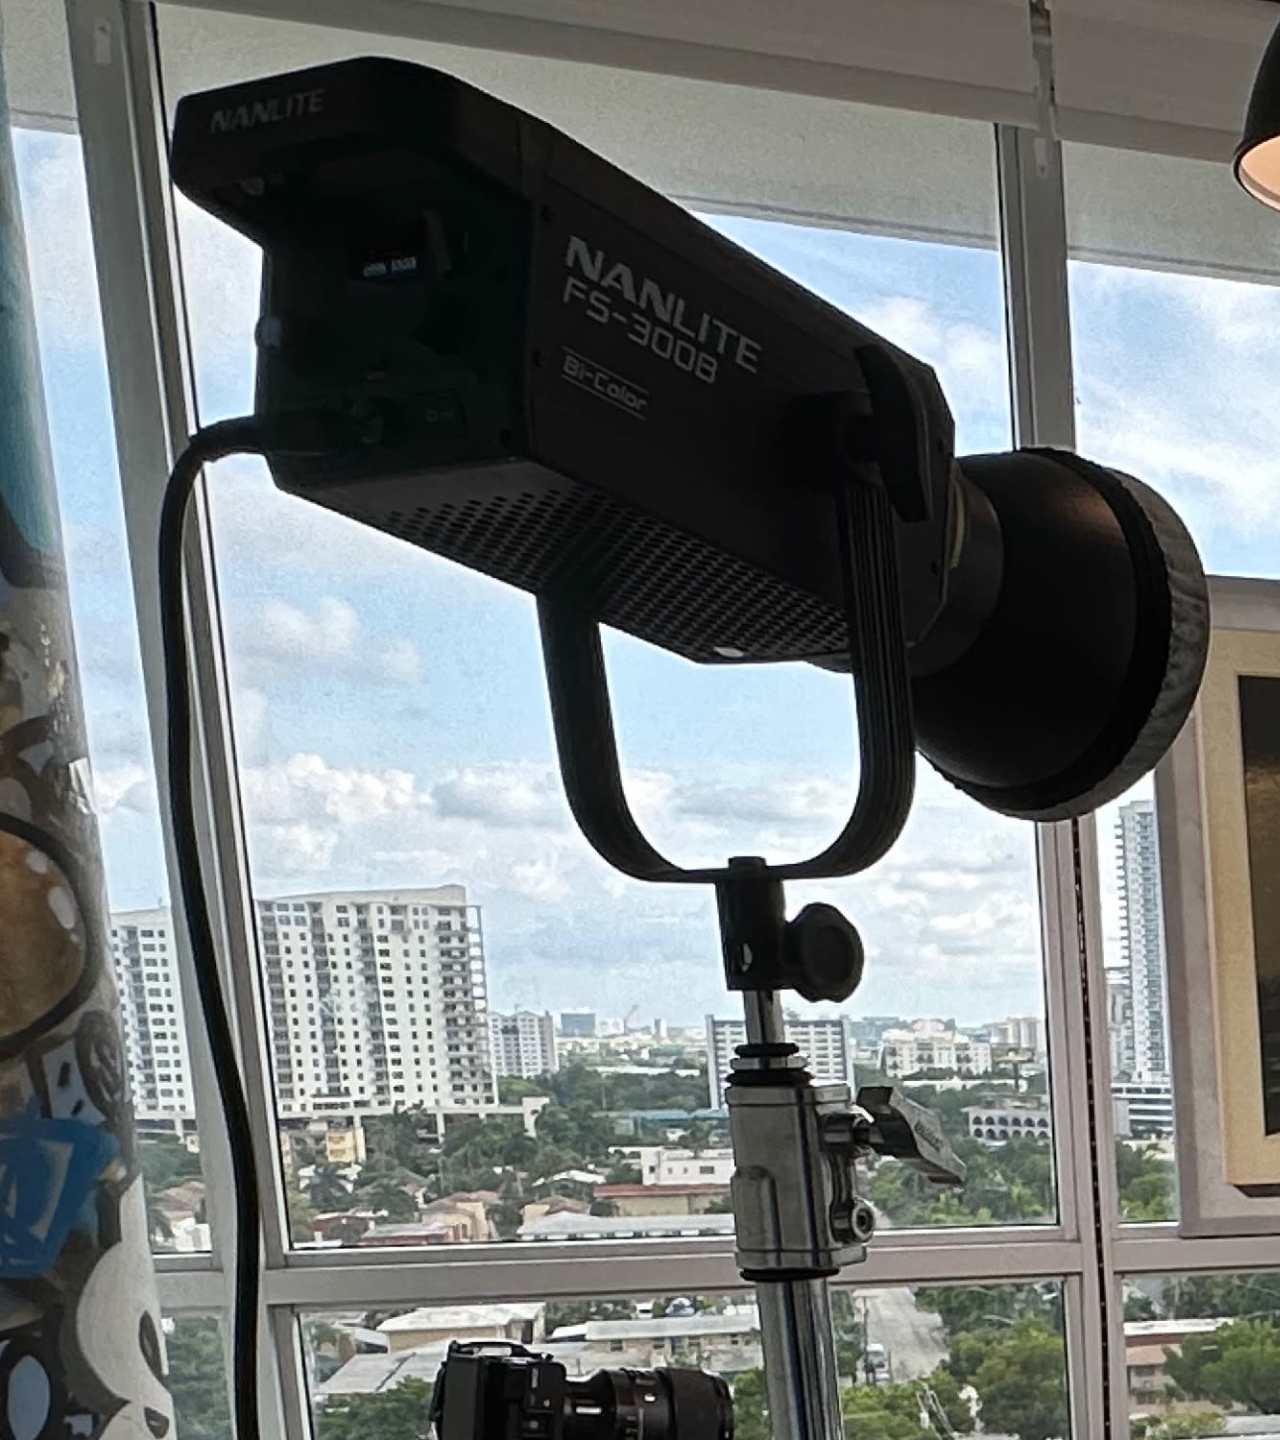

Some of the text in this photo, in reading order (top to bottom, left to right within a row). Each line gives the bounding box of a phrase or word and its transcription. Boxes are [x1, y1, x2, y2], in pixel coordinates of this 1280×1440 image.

[209, 87, 326, 134] NANLITE
[563, 275, 719, 384] FS-300B
[565, 234, 762, 375] NANLITE
[563, 354, 648, 411] Bi-Color
